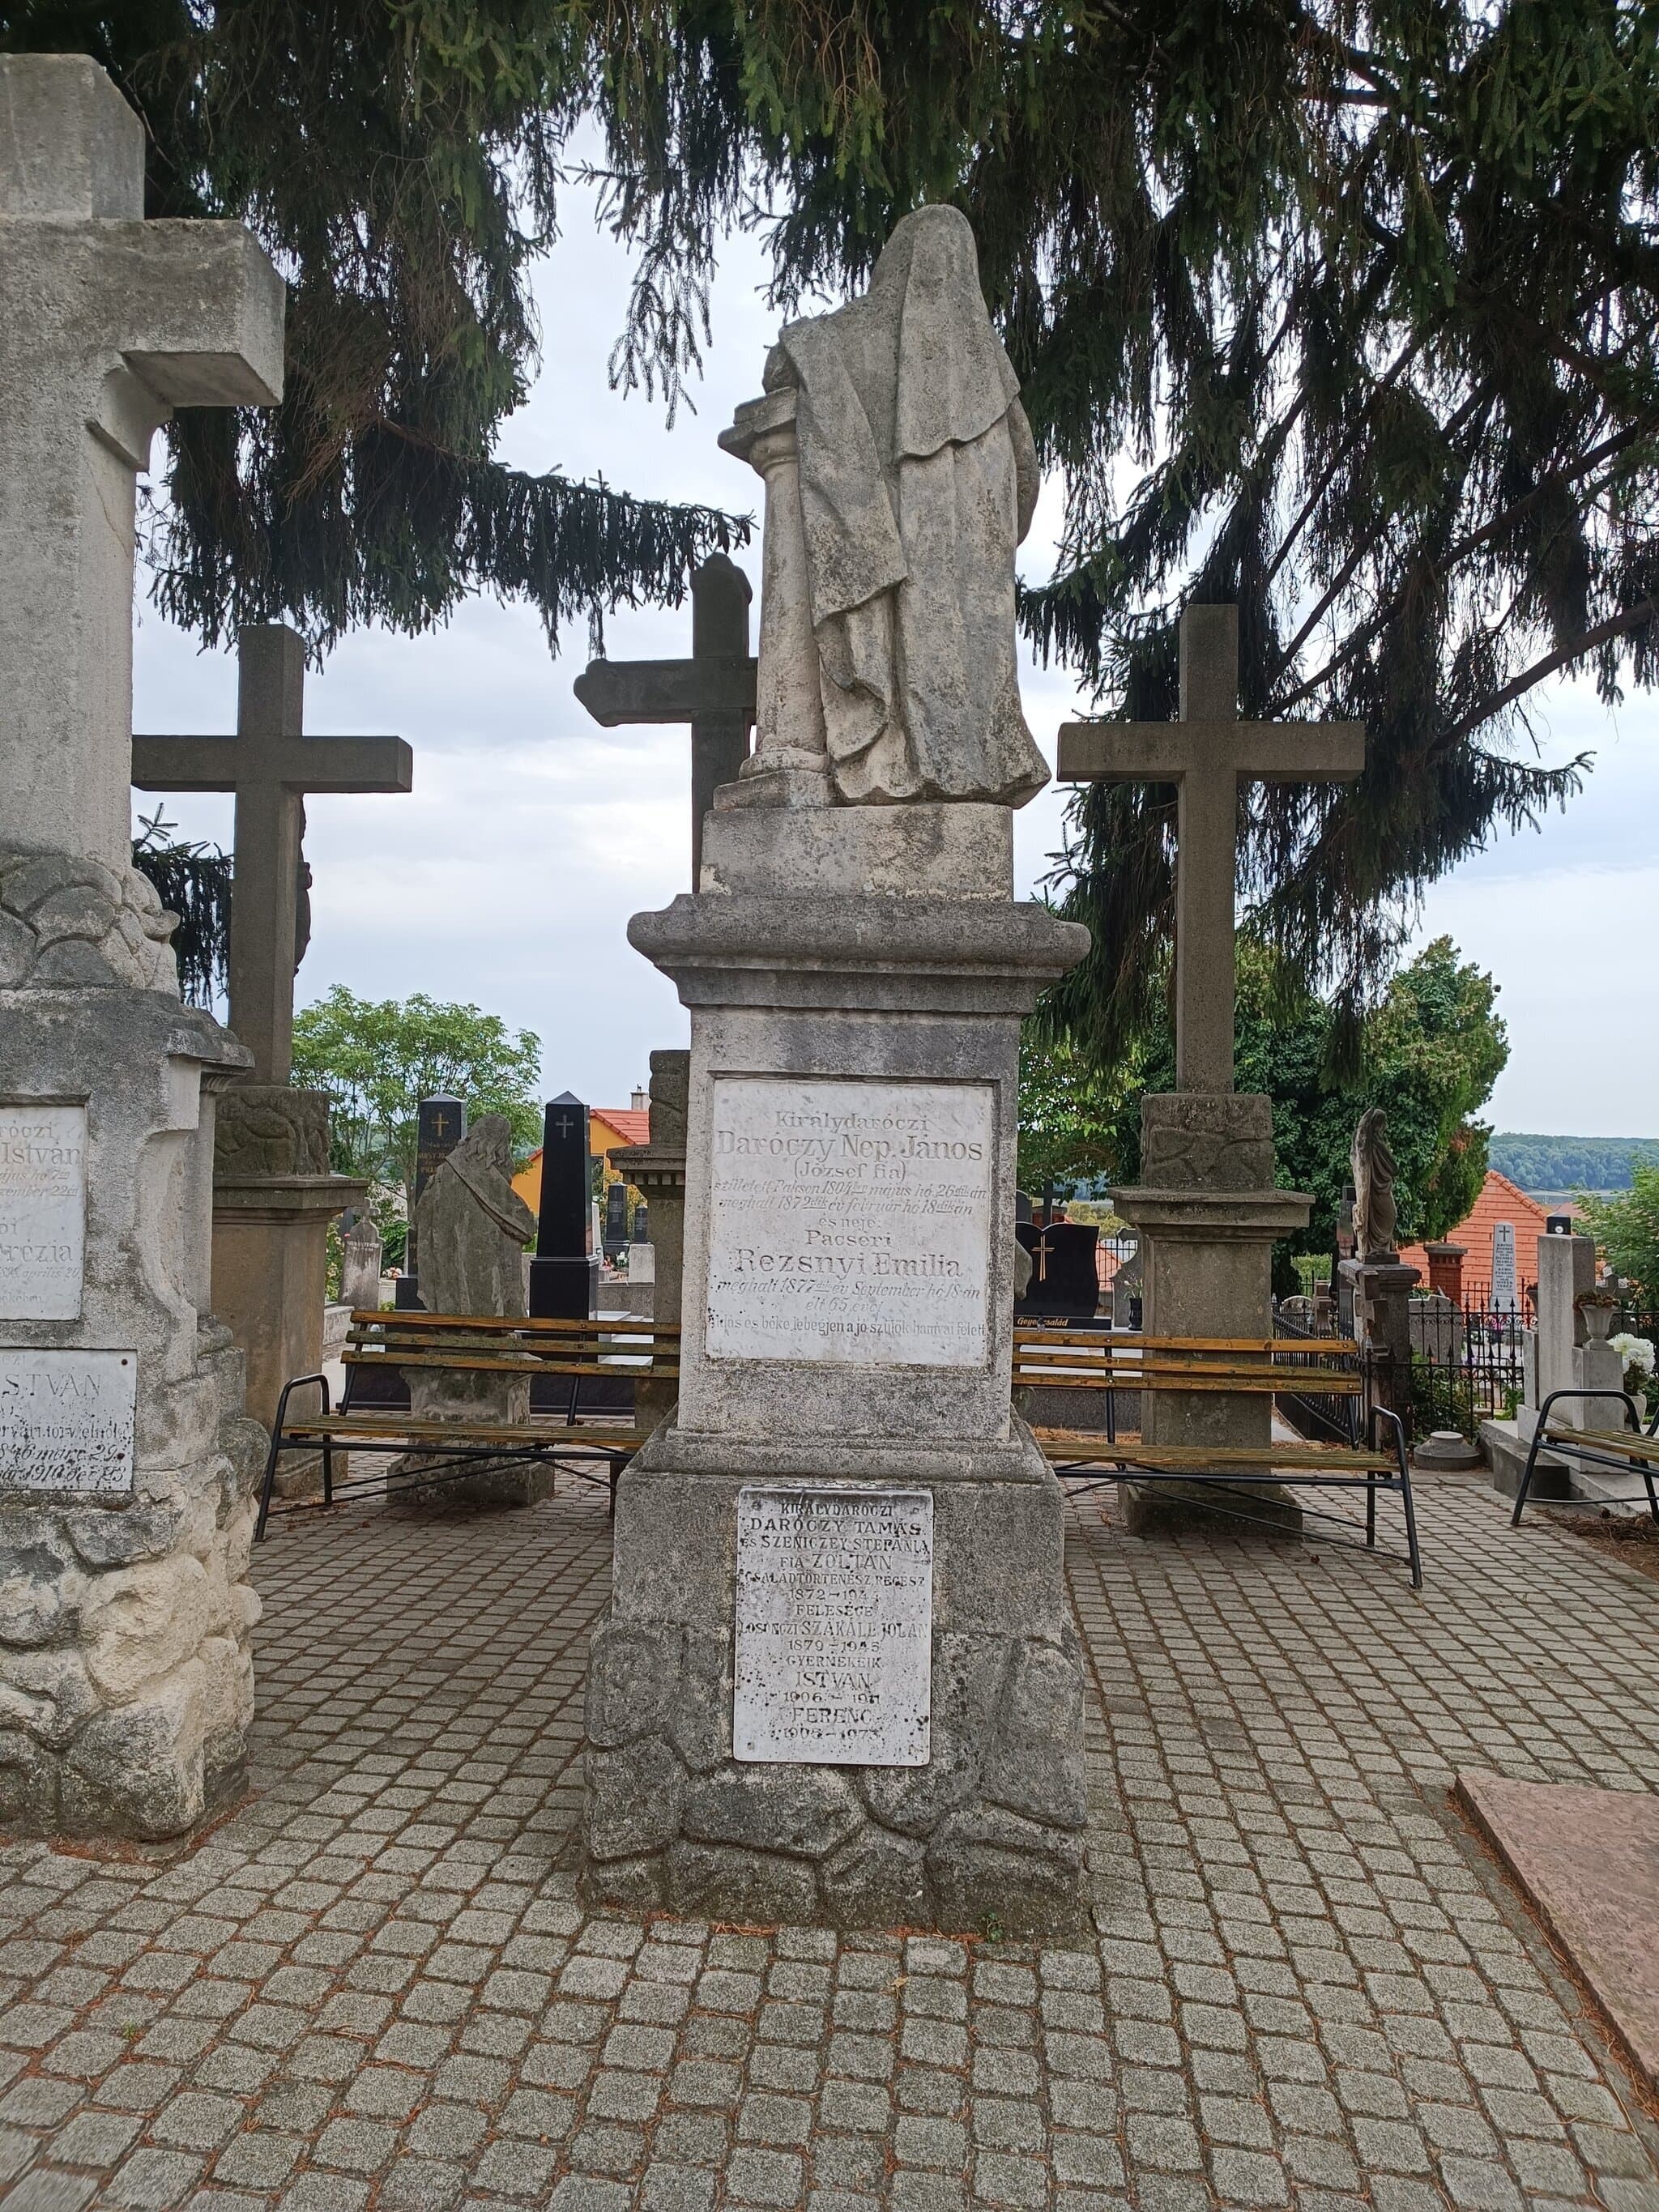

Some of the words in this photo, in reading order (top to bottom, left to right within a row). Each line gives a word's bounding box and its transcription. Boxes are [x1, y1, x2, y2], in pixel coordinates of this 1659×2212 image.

[716, 1129, 837, 1163] Daróczy
[900, 1134, 983, 1161] János
[1017, 1317, 1043, 1327] Geye
[750, 1515, 845, 1534] DARÓCZY
